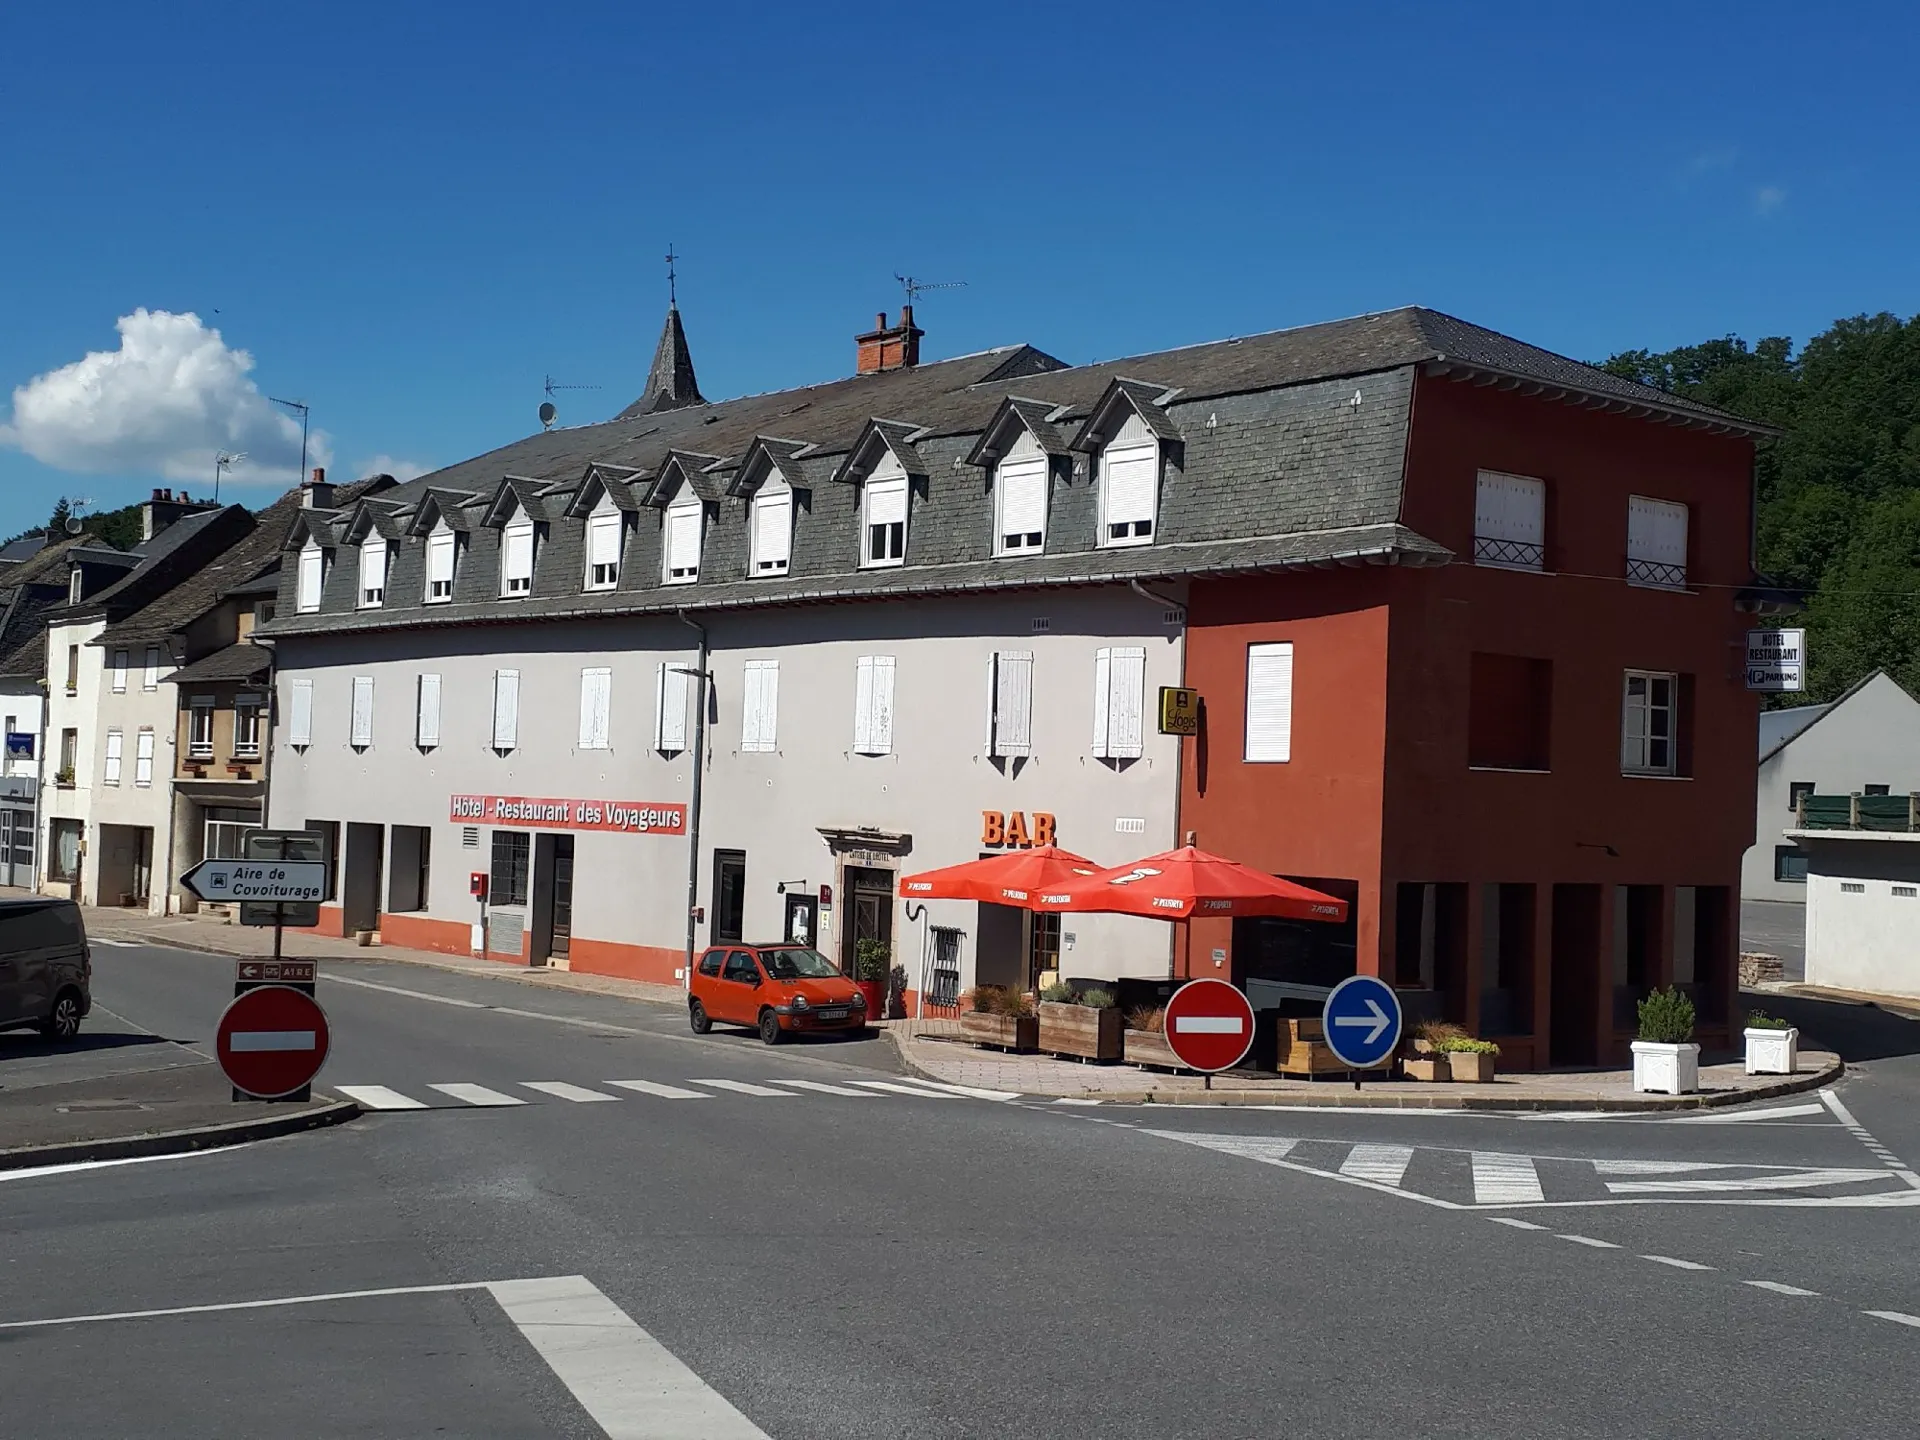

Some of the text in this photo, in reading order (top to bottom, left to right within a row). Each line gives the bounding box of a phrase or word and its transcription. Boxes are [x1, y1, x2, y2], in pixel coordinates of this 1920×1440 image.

[1762, 634, 1785, 646] HOTEL
[1749, 648, 1798, 660] RESTAURANT
[1765, 673, 1798, 682] PARKING
[1166, 708, 1196, 732] Logis
[453, 797, 486, 818] Hôtel
[496, 798, 570, 822] Restaurant
[576, 801, 602, 824] des
[605, 803, 682, 832] Voyageurs
[981, 811, 1057, 847] BAR
[233, 867, 286, 880] Aire de
[232, 883, 320, 899] Covoiturage
[283, 967, 312, 977] AIRE
